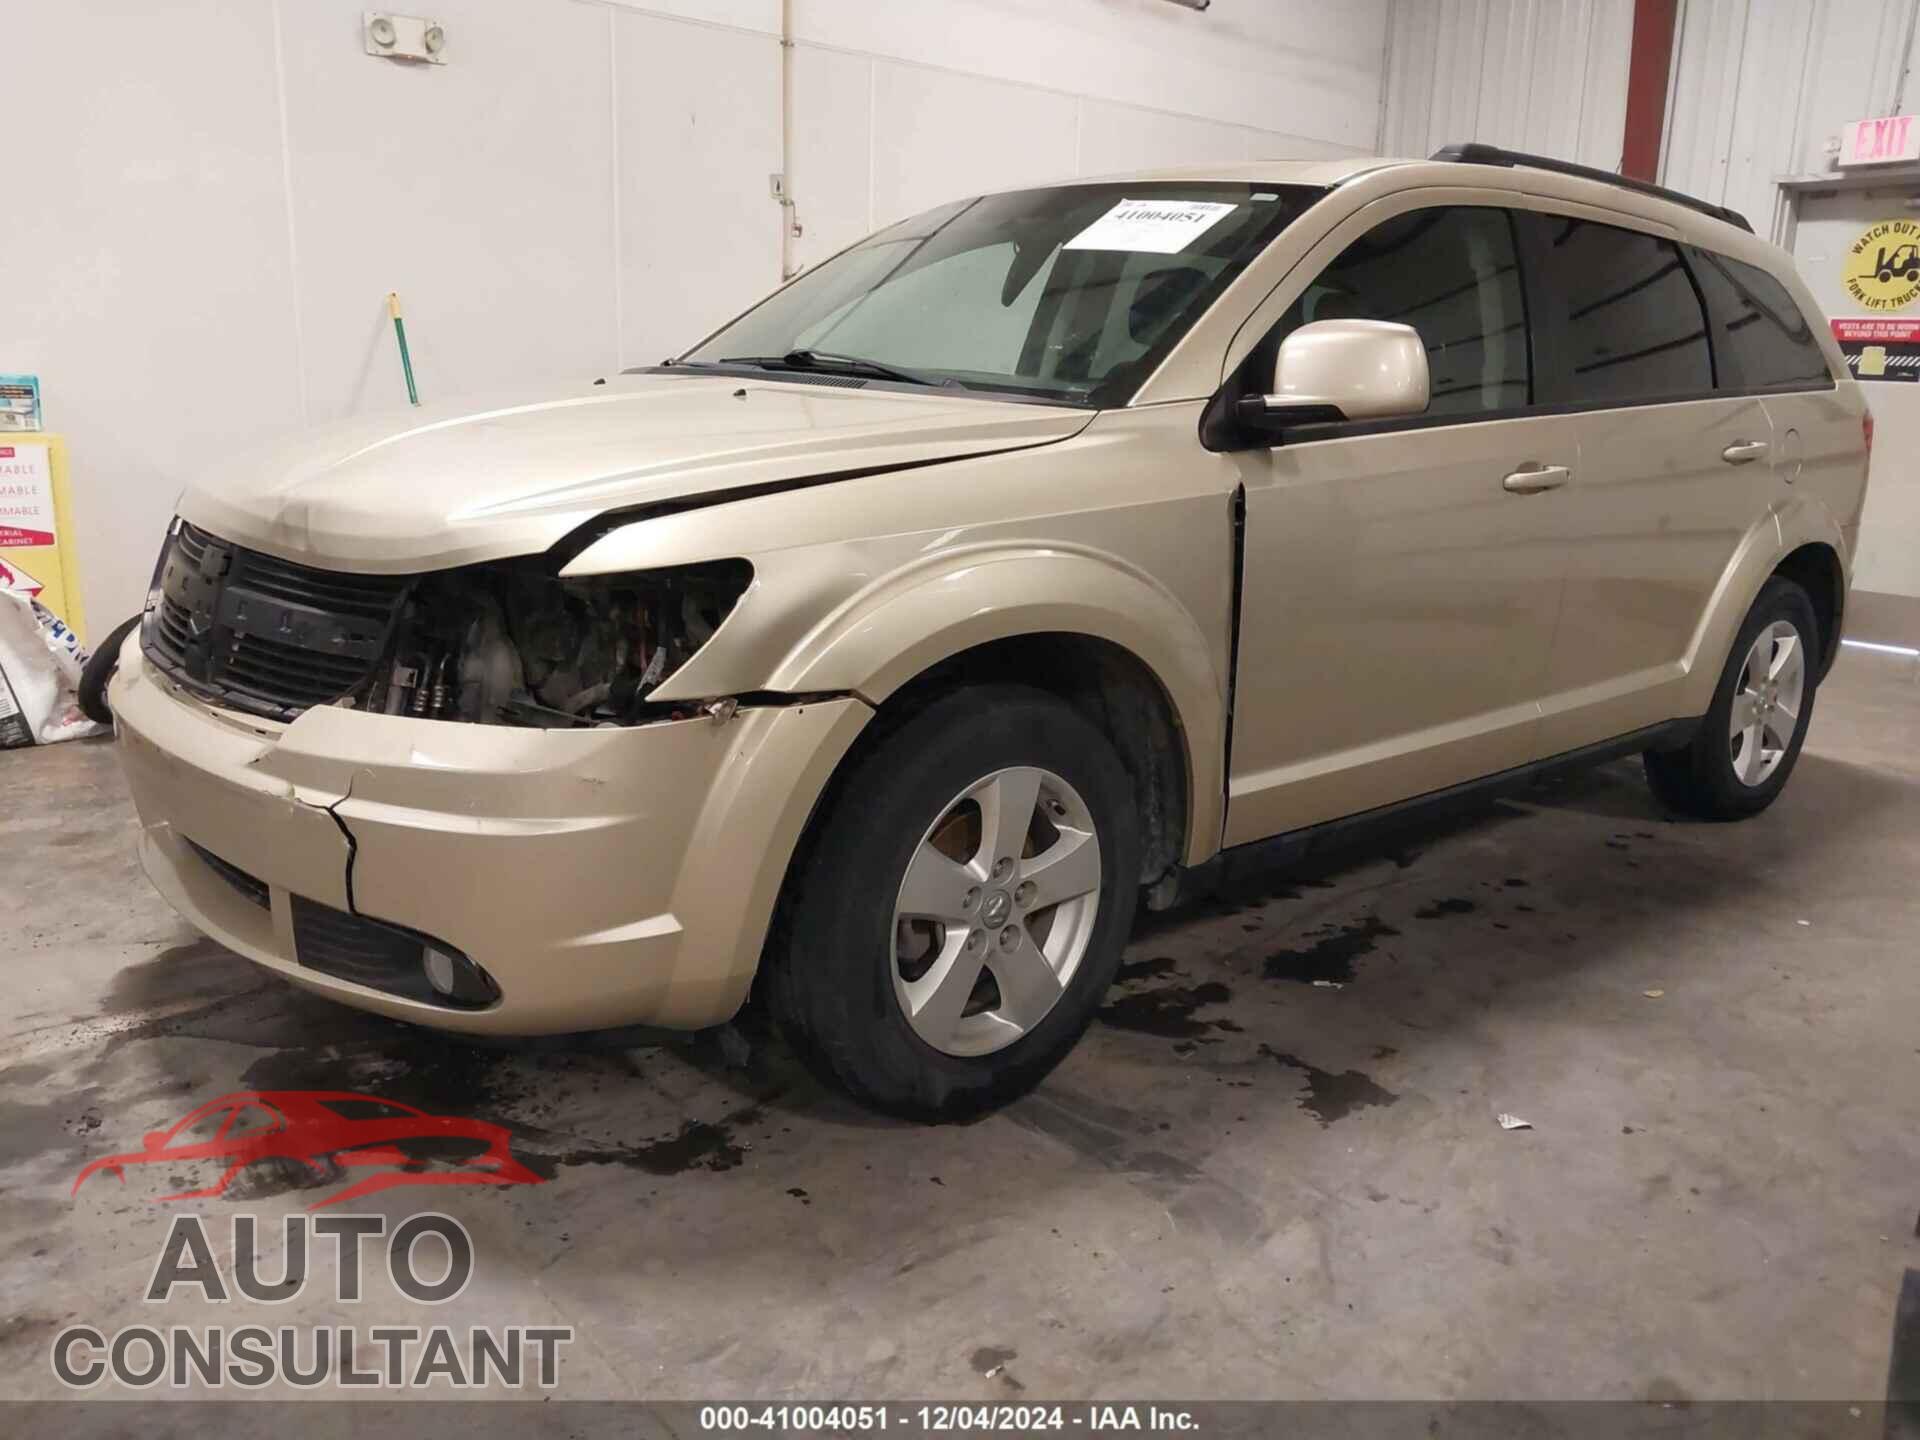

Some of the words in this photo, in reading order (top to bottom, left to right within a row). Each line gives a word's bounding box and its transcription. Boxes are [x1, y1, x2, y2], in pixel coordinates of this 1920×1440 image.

[1856, 117, 1913, 160] EXIT
[1852, 224, 1890, 255] WATCH
[1894, 222, 1918, 237] OUT
[1847, 278, 1867, 301] FORK
[1865, 296, 1888, 309] LIFT
